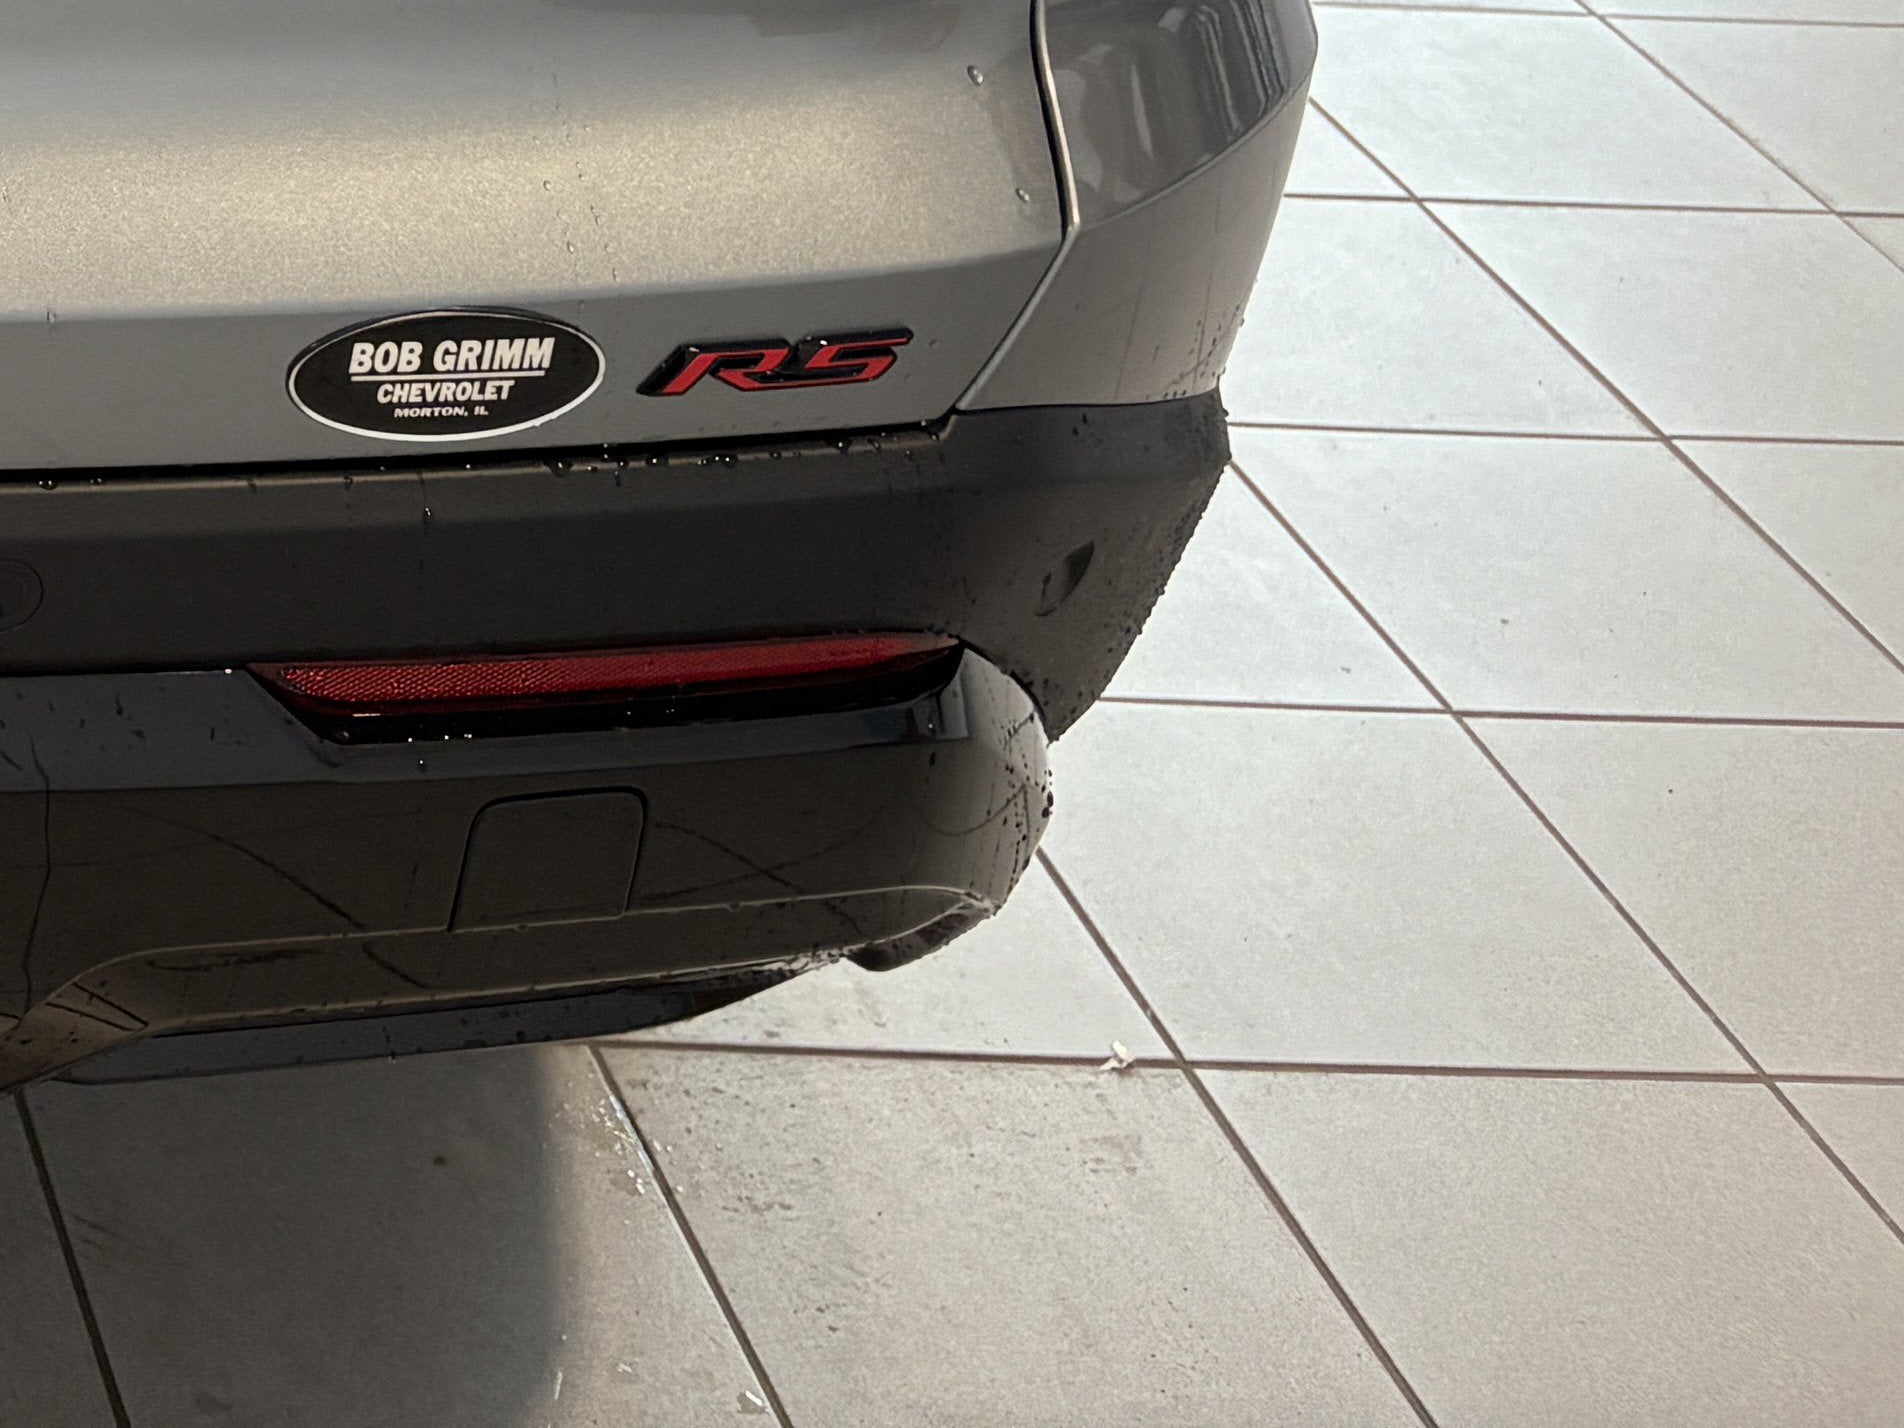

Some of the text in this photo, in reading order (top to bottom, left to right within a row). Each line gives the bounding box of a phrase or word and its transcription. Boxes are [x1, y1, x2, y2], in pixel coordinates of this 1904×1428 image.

[348, 337, 556, 374] BOB GRIMM
[635, 326, 915, 398] RS
[376, 380, 516, 404] CHEVROLET
[393, 404, 489, 418] MORTON, IL
